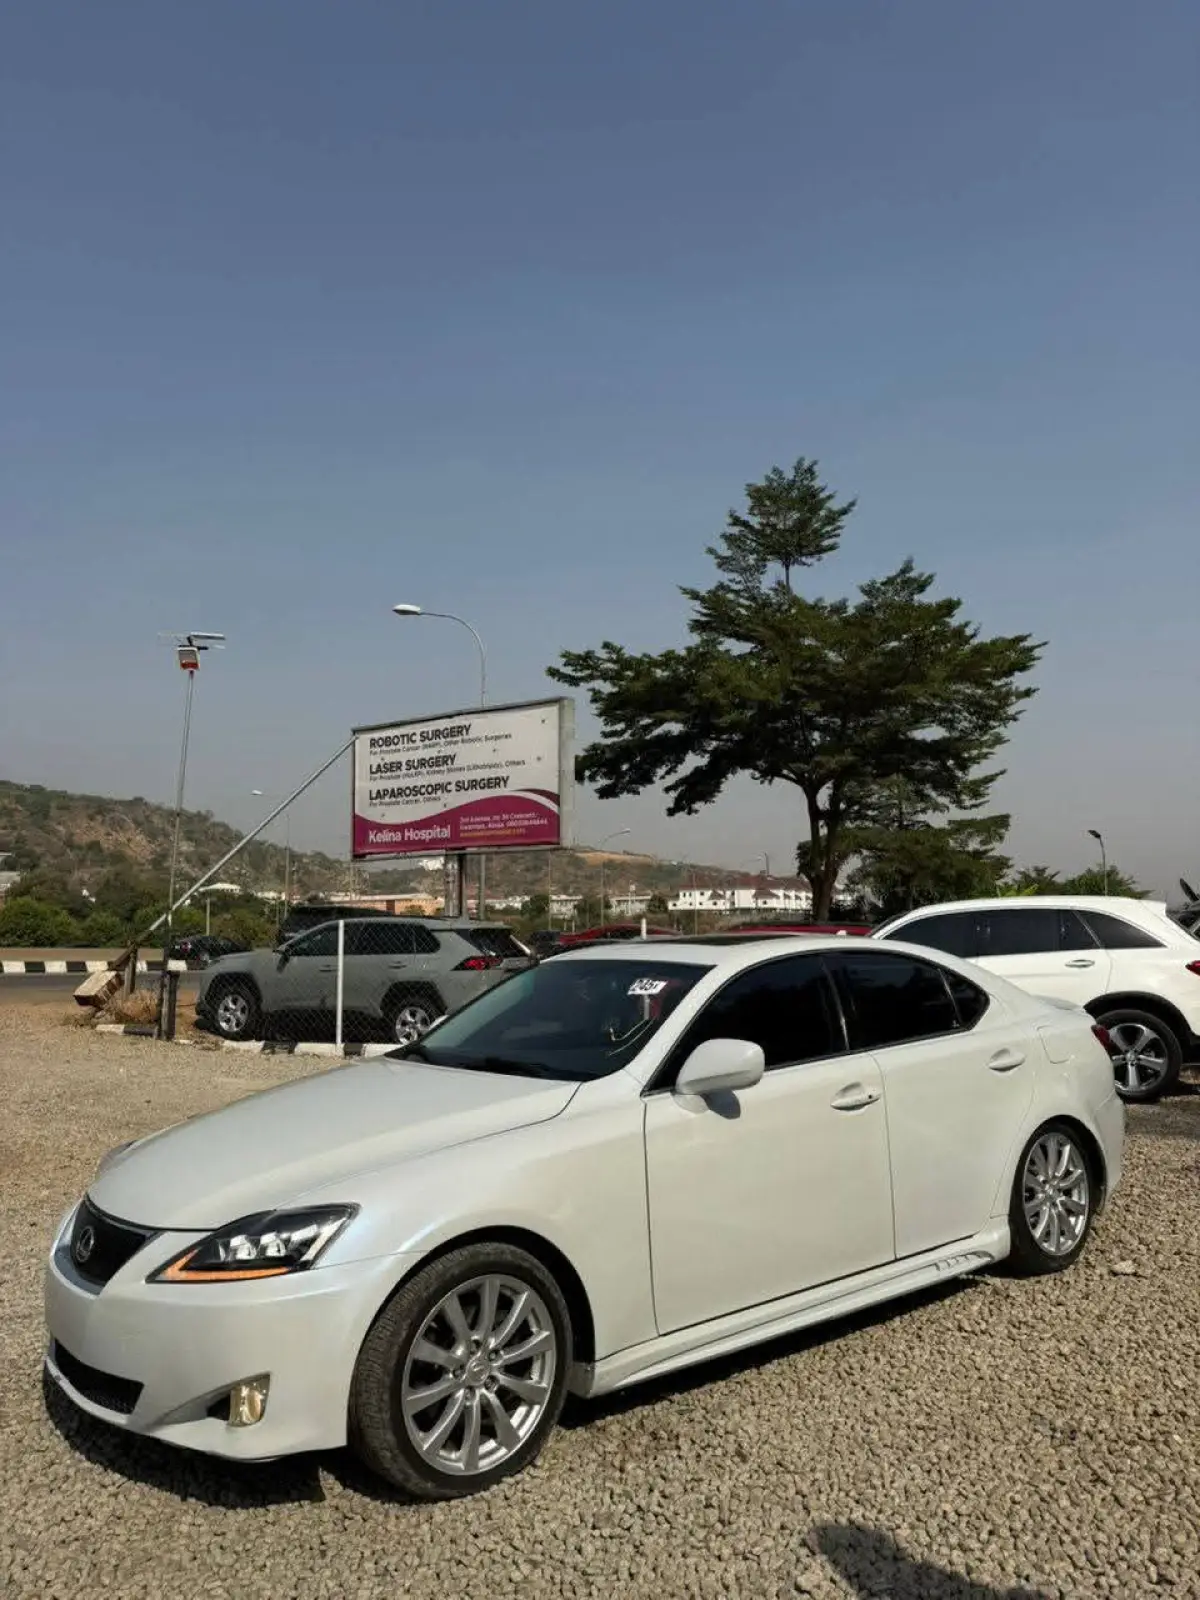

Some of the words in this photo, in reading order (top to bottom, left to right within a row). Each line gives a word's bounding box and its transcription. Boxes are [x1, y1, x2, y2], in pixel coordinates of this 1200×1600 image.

[370, 732, 416, 748] ROBOTIC
[419, 723, 471, 742] SURGERY
[370, 761, 402, 774] LASER
[405, 753, 457, 770] SURGERY
[369, 782, 452, 800] LAPAROSCOPIC
[455, 776, 510, 791] SURGERY
[368, 827, 402, 844] Kelina
[405, 825, 451, 842] Hospital
